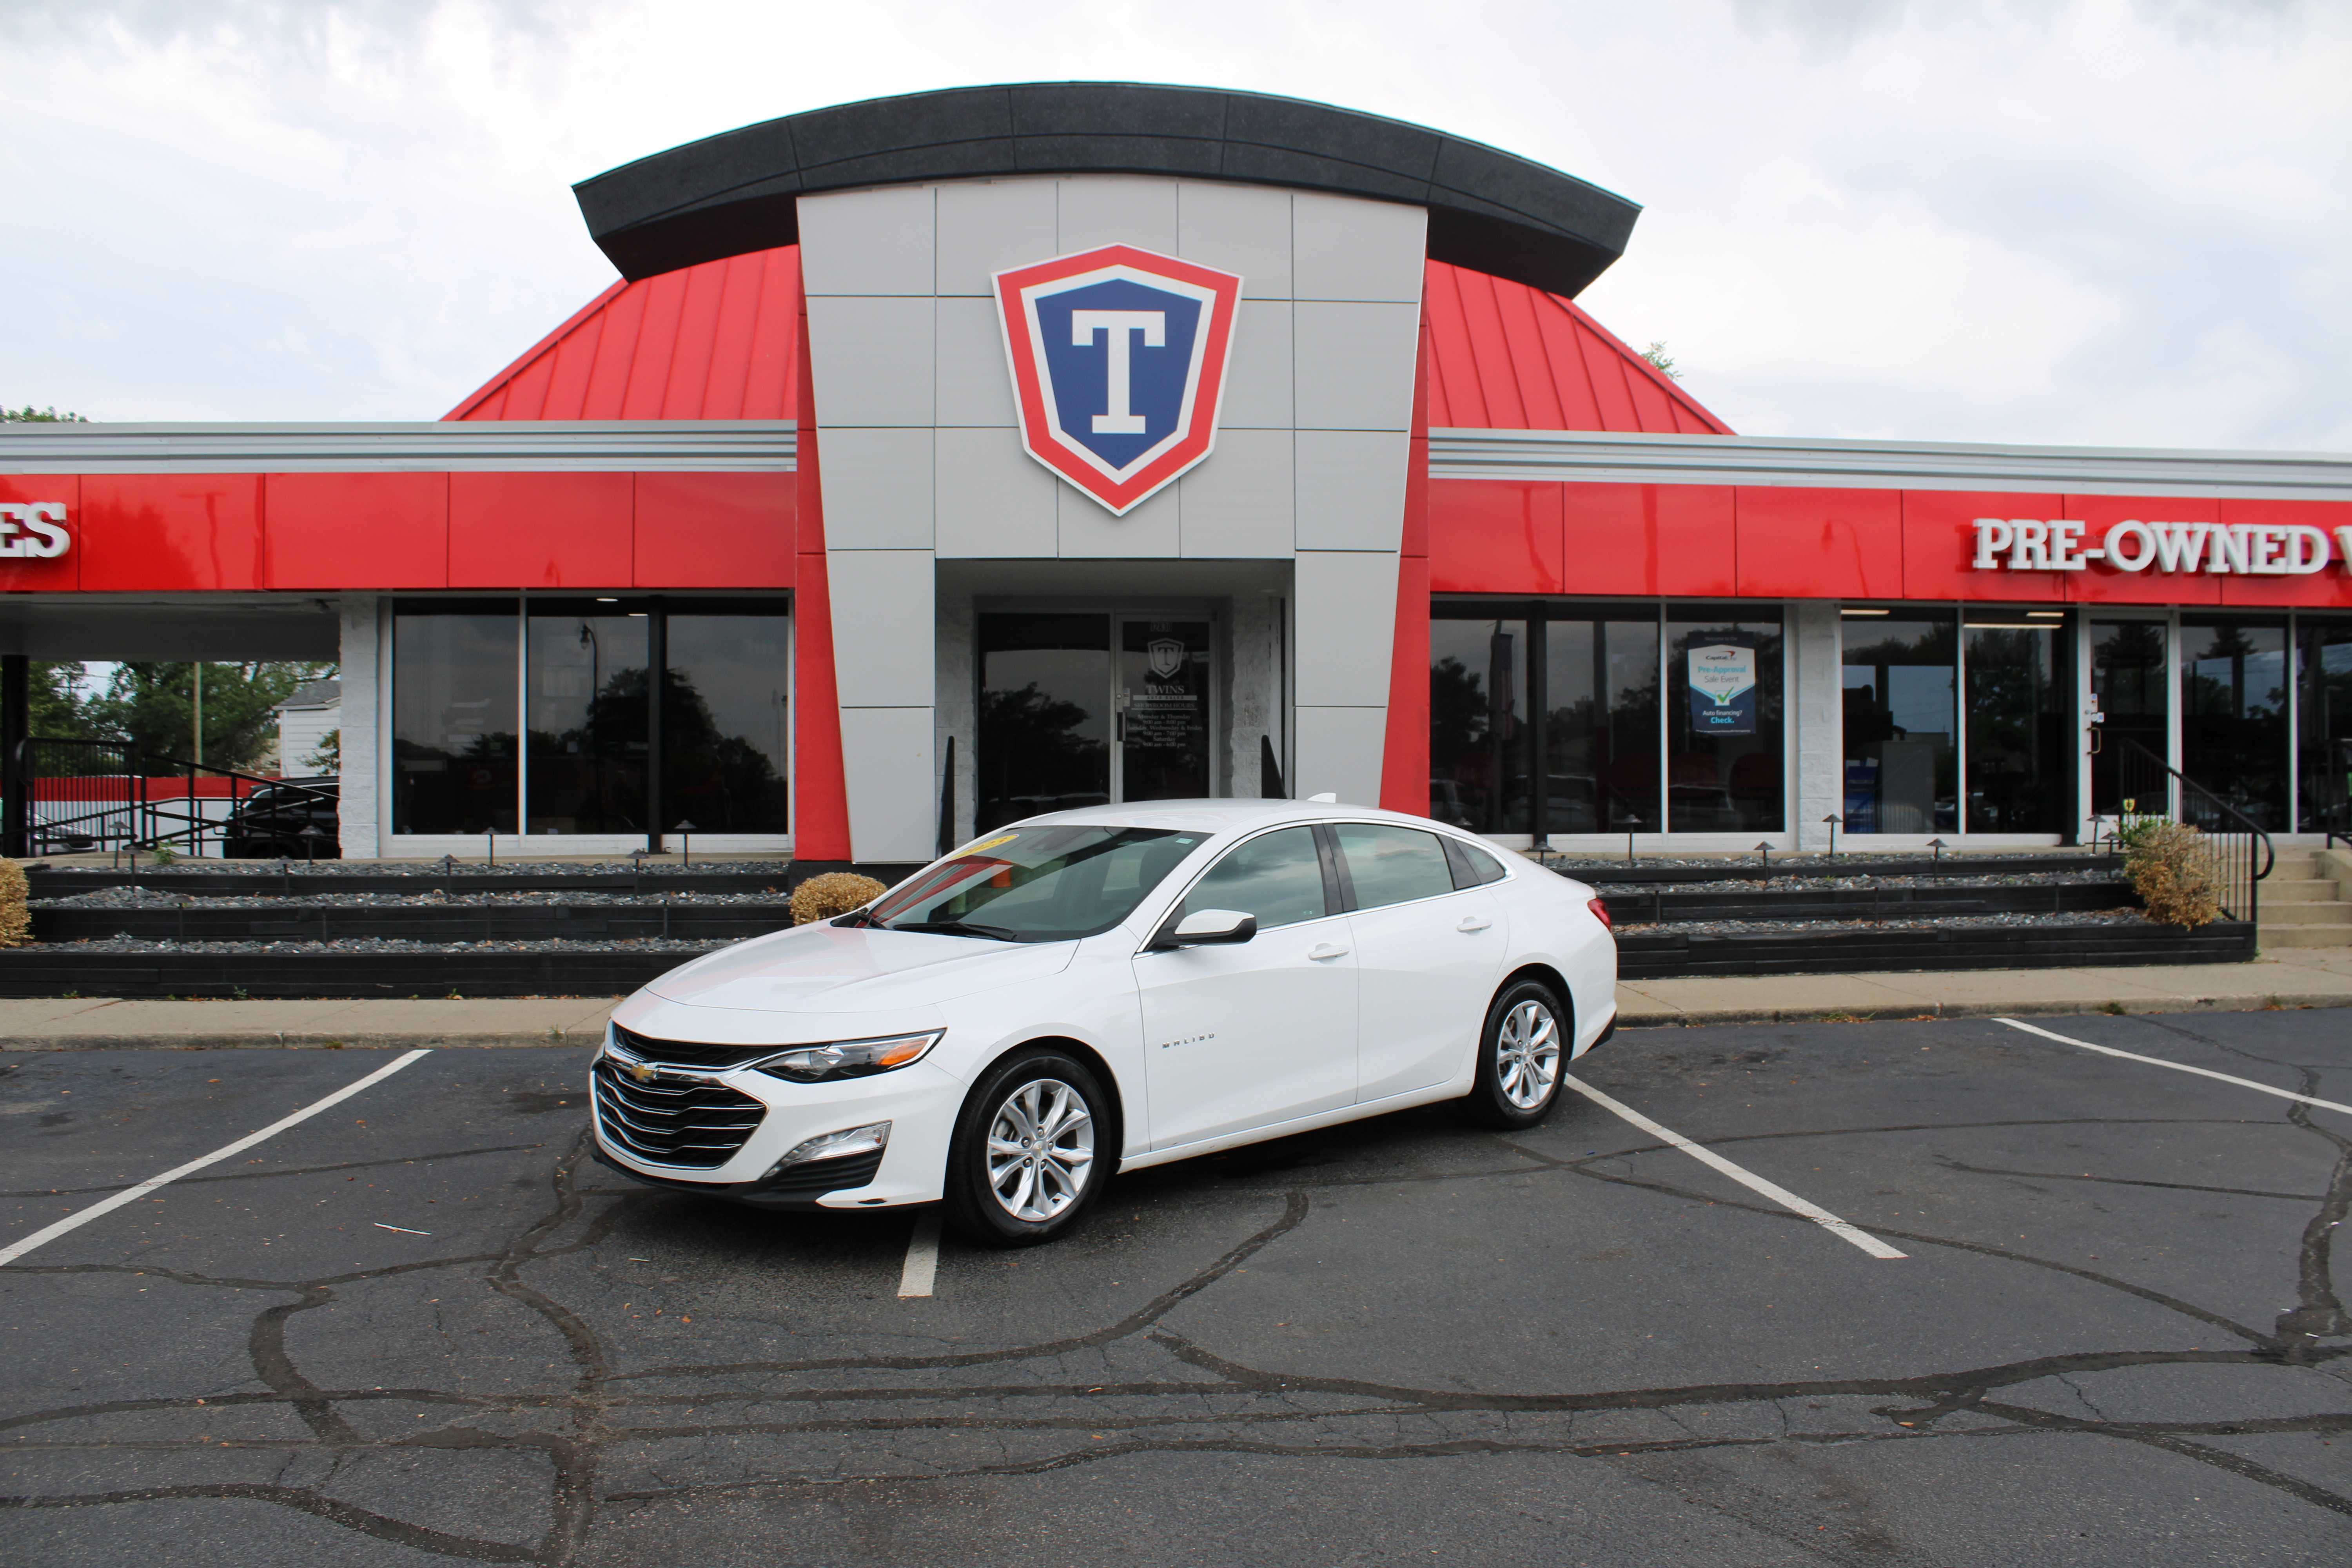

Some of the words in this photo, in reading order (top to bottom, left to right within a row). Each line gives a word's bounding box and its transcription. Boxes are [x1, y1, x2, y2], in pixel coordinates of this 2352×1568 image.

[1072, 309, 1165, 434] T
[0, 502, 71, 557] ES
[1973, 518, 2330, 574] PRE-OWNED
[1158, 647, 1174, 666] T
[1697, 666, 1746, 674] Pre-Approval
[1146, 685, 1185, 694] TWINS
[1162, 1032, 1215, 1049] MALIBU
